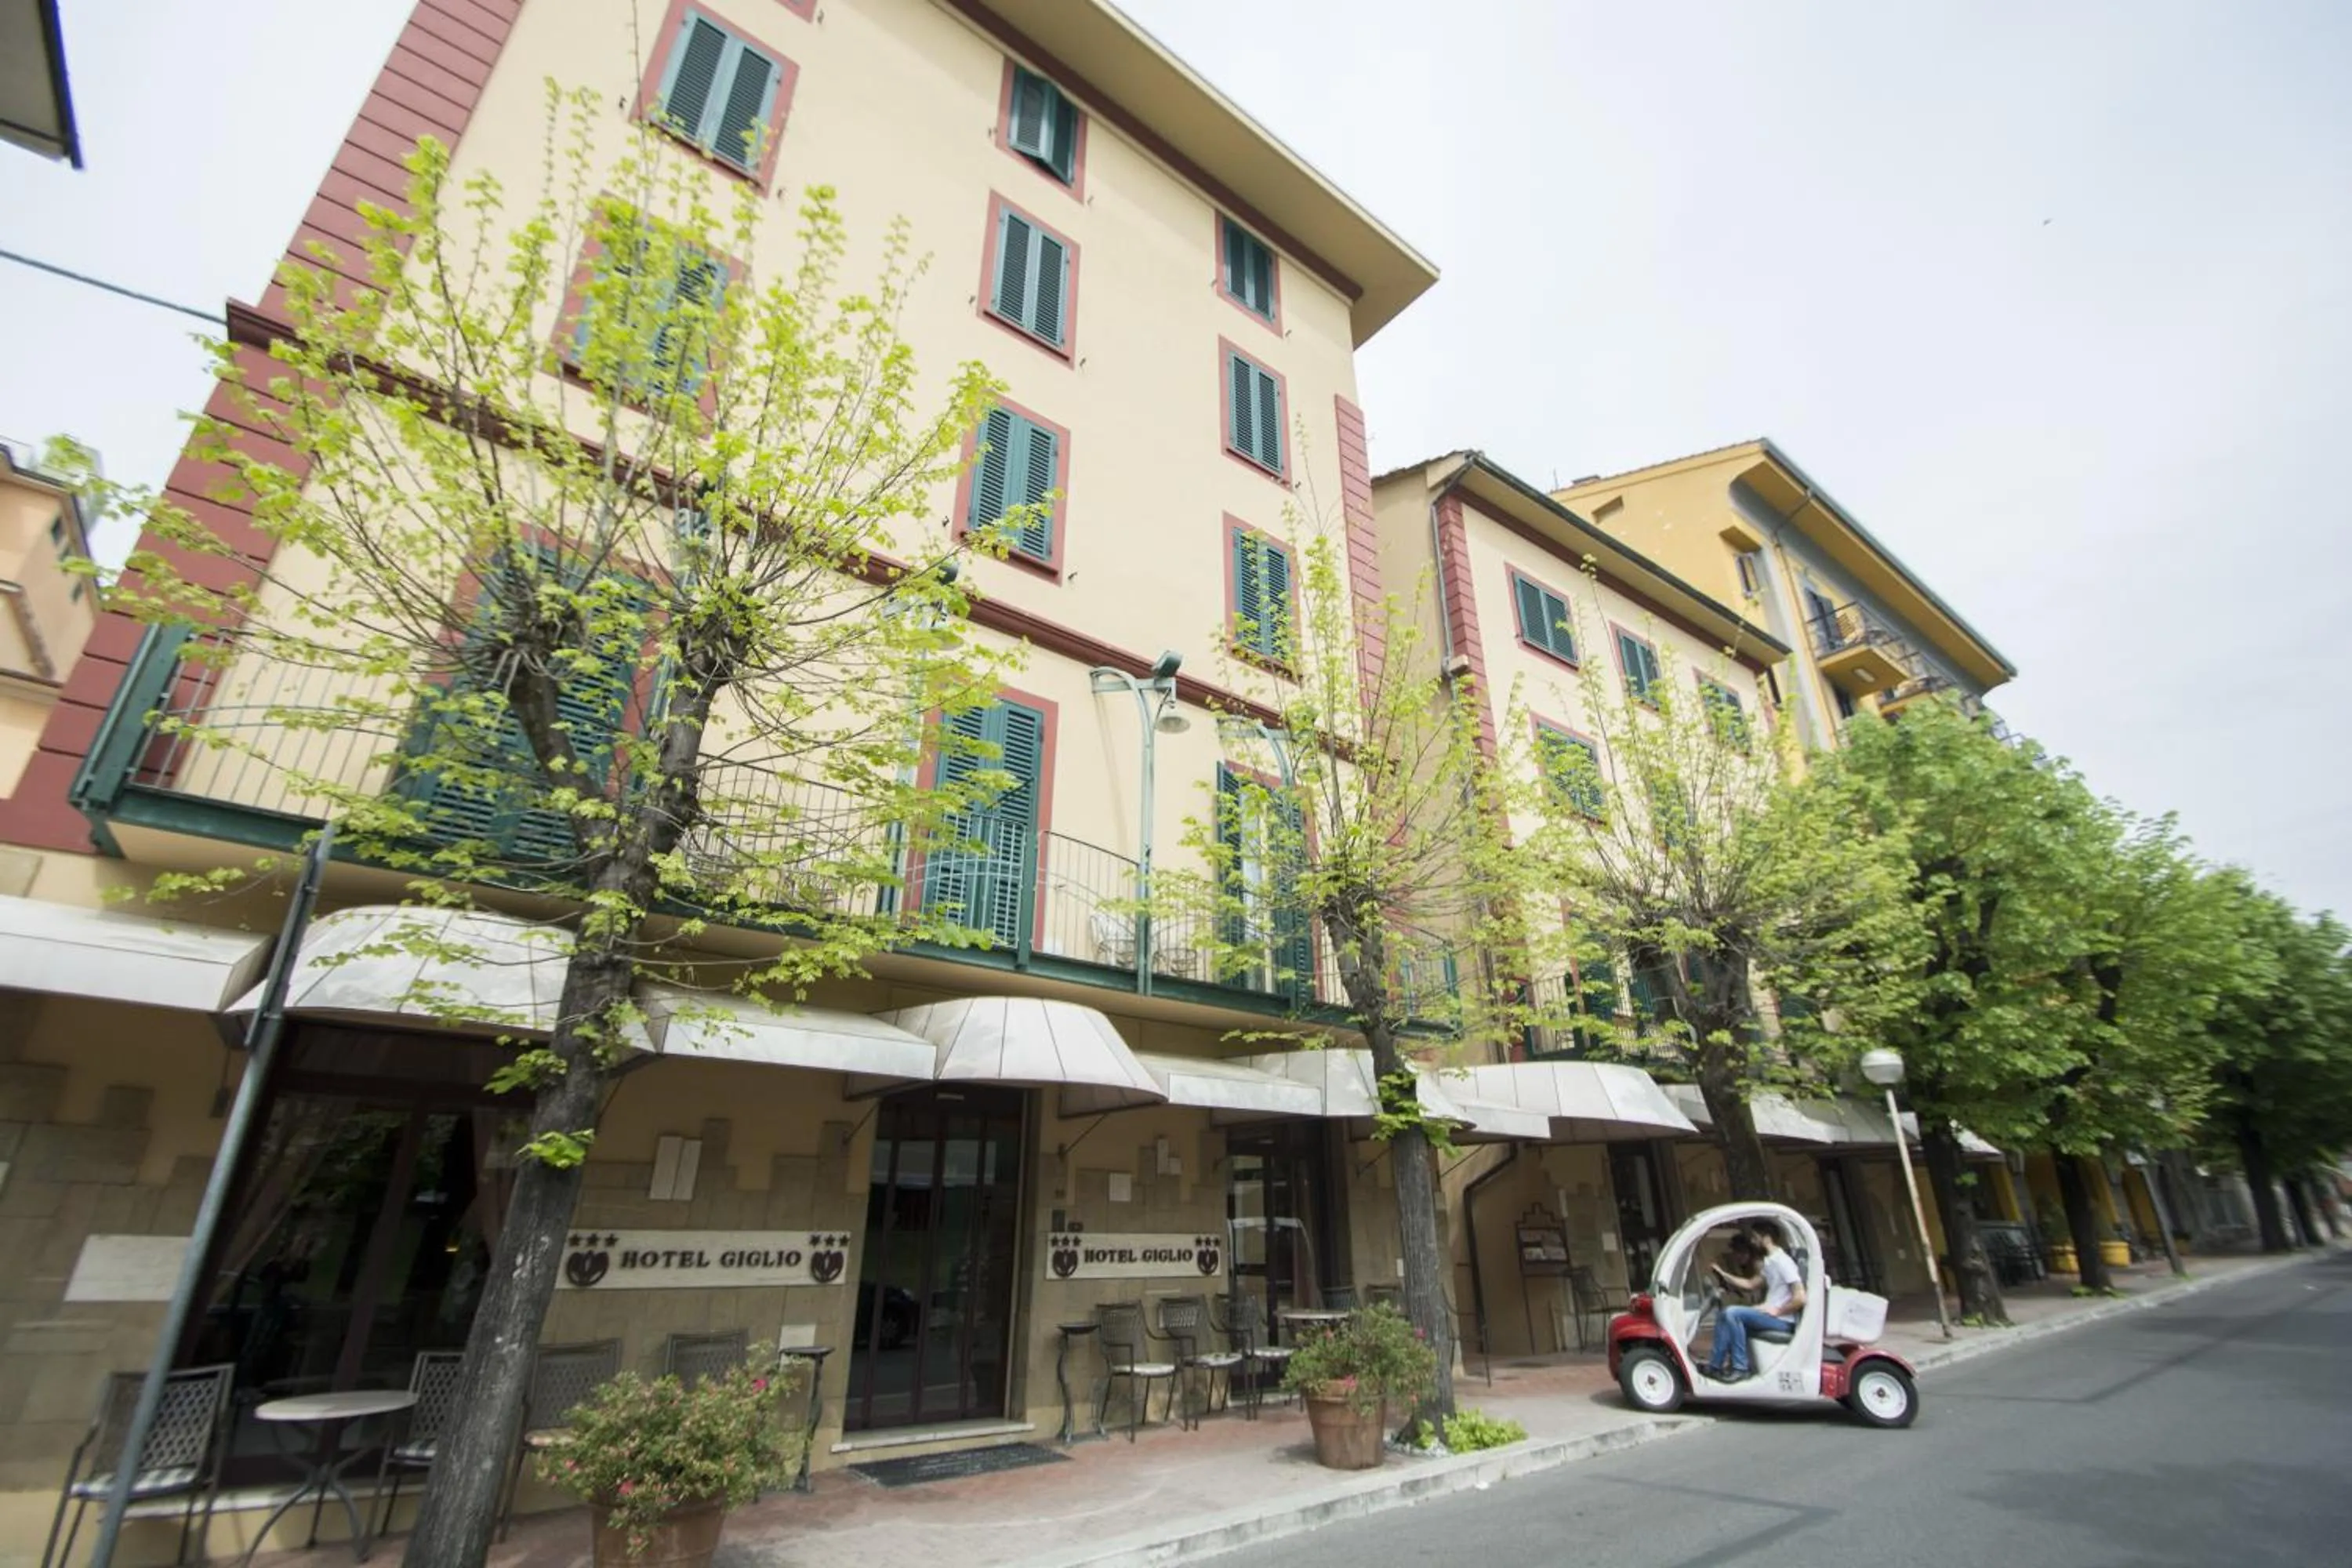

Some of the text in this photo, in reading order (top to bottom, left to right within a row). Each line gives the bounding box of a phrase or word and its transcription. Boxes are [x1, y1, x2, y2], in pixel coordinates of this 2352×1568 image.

[620, 1249, 801, 1269] HOTEL GIGLIO
[1083, 1250, 1192, 1263] HOTEL GIGLIO
